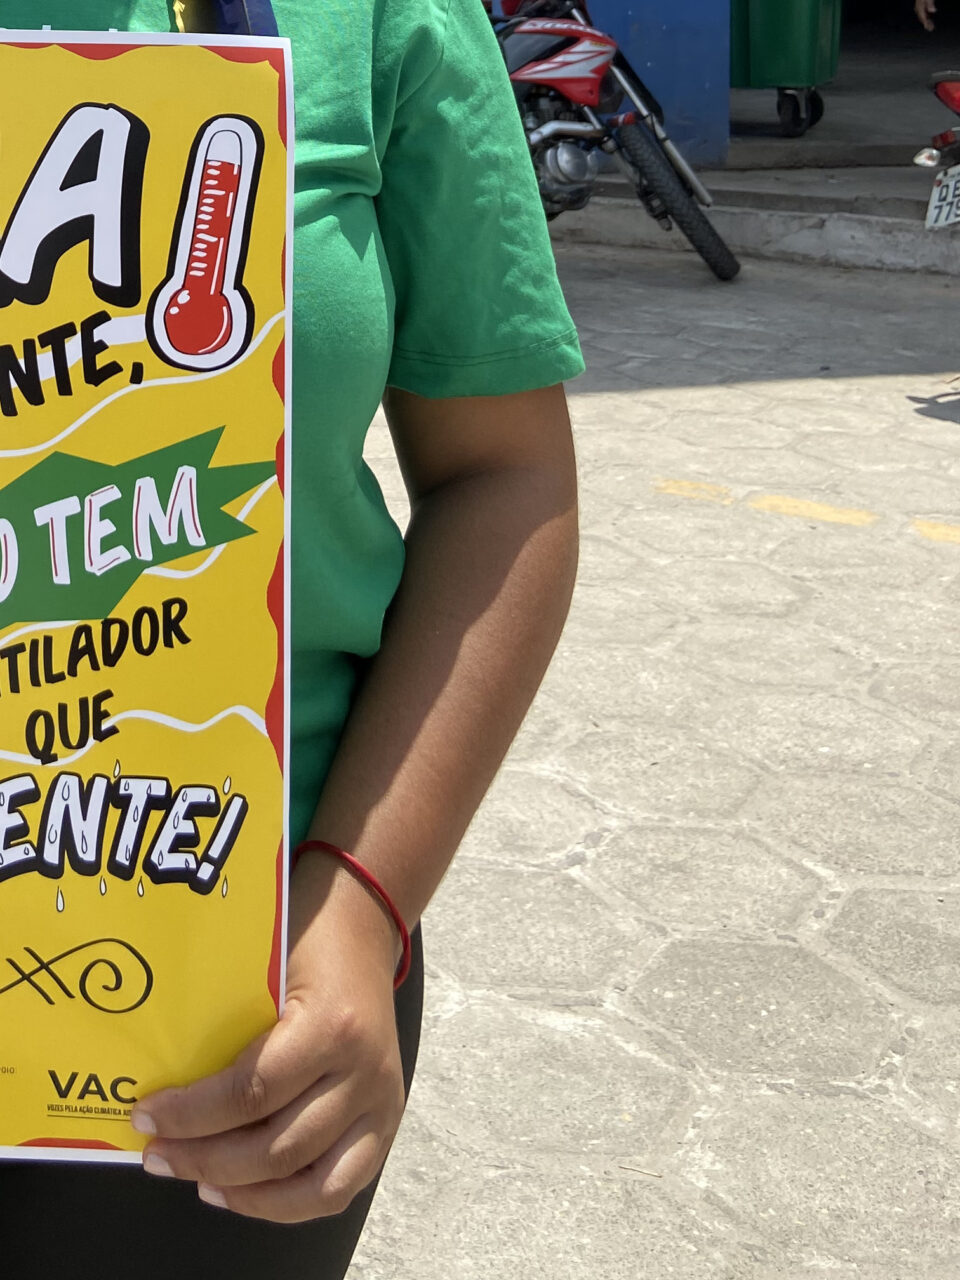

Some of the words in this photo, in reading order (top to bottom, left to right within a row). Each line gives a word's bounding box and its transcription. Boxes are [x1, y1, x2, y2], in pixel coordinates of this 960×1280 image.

[33, 465, 206, 585] TEM
[25, 689, 120, 766] QUE
[47, 1069, 138, 1104] VAC
[64, 1105, 78, 1113] PELA
